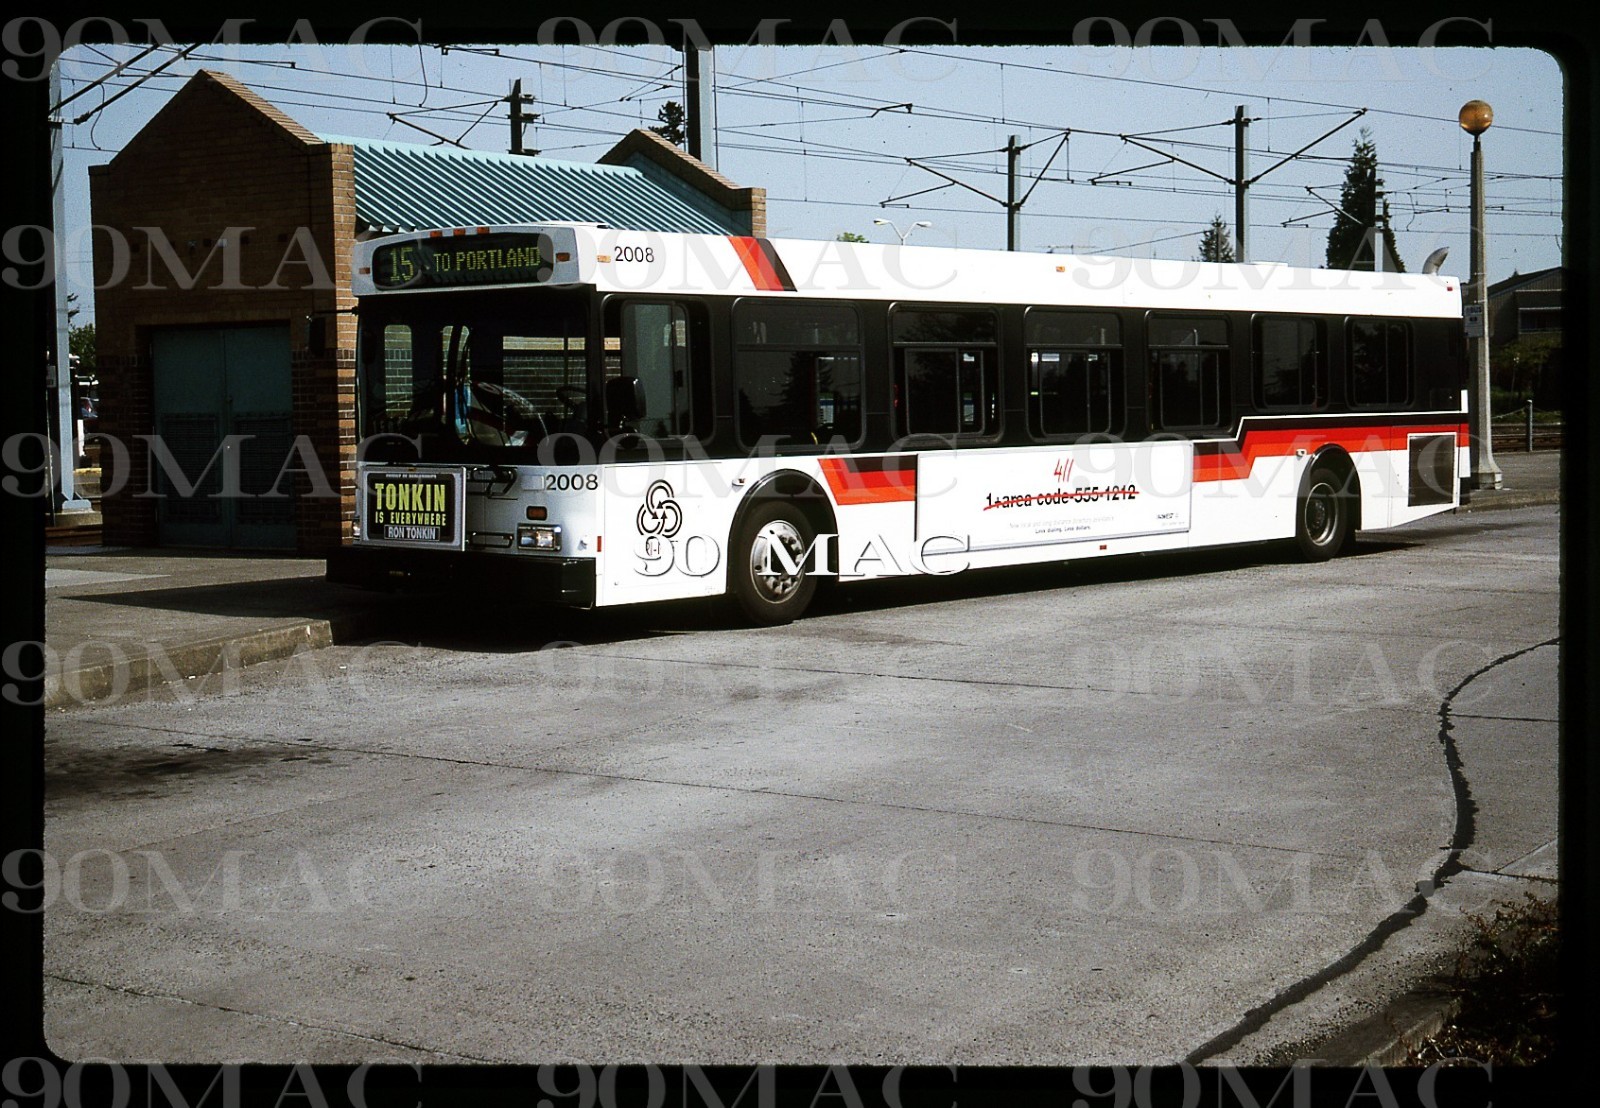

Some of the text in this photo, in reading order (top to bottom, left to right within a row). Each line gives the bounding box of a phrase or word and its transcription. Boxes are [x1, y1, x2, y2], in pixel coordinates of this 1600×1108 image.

[389, 246, 541, 281] 15 TO PORTLAND
[614, 245, 655, 264] 2008
[1053, 458, 1075, 483] 411
[545, 474, 599, 491] 2008
[374, 483, 446, 512] TONKIN
[1036, 484, 1136, 505] code-555-1212
[374, 511, 447, 527] IS EVERYWHERE
[388, 526, 436, 540] RON TONKIN
